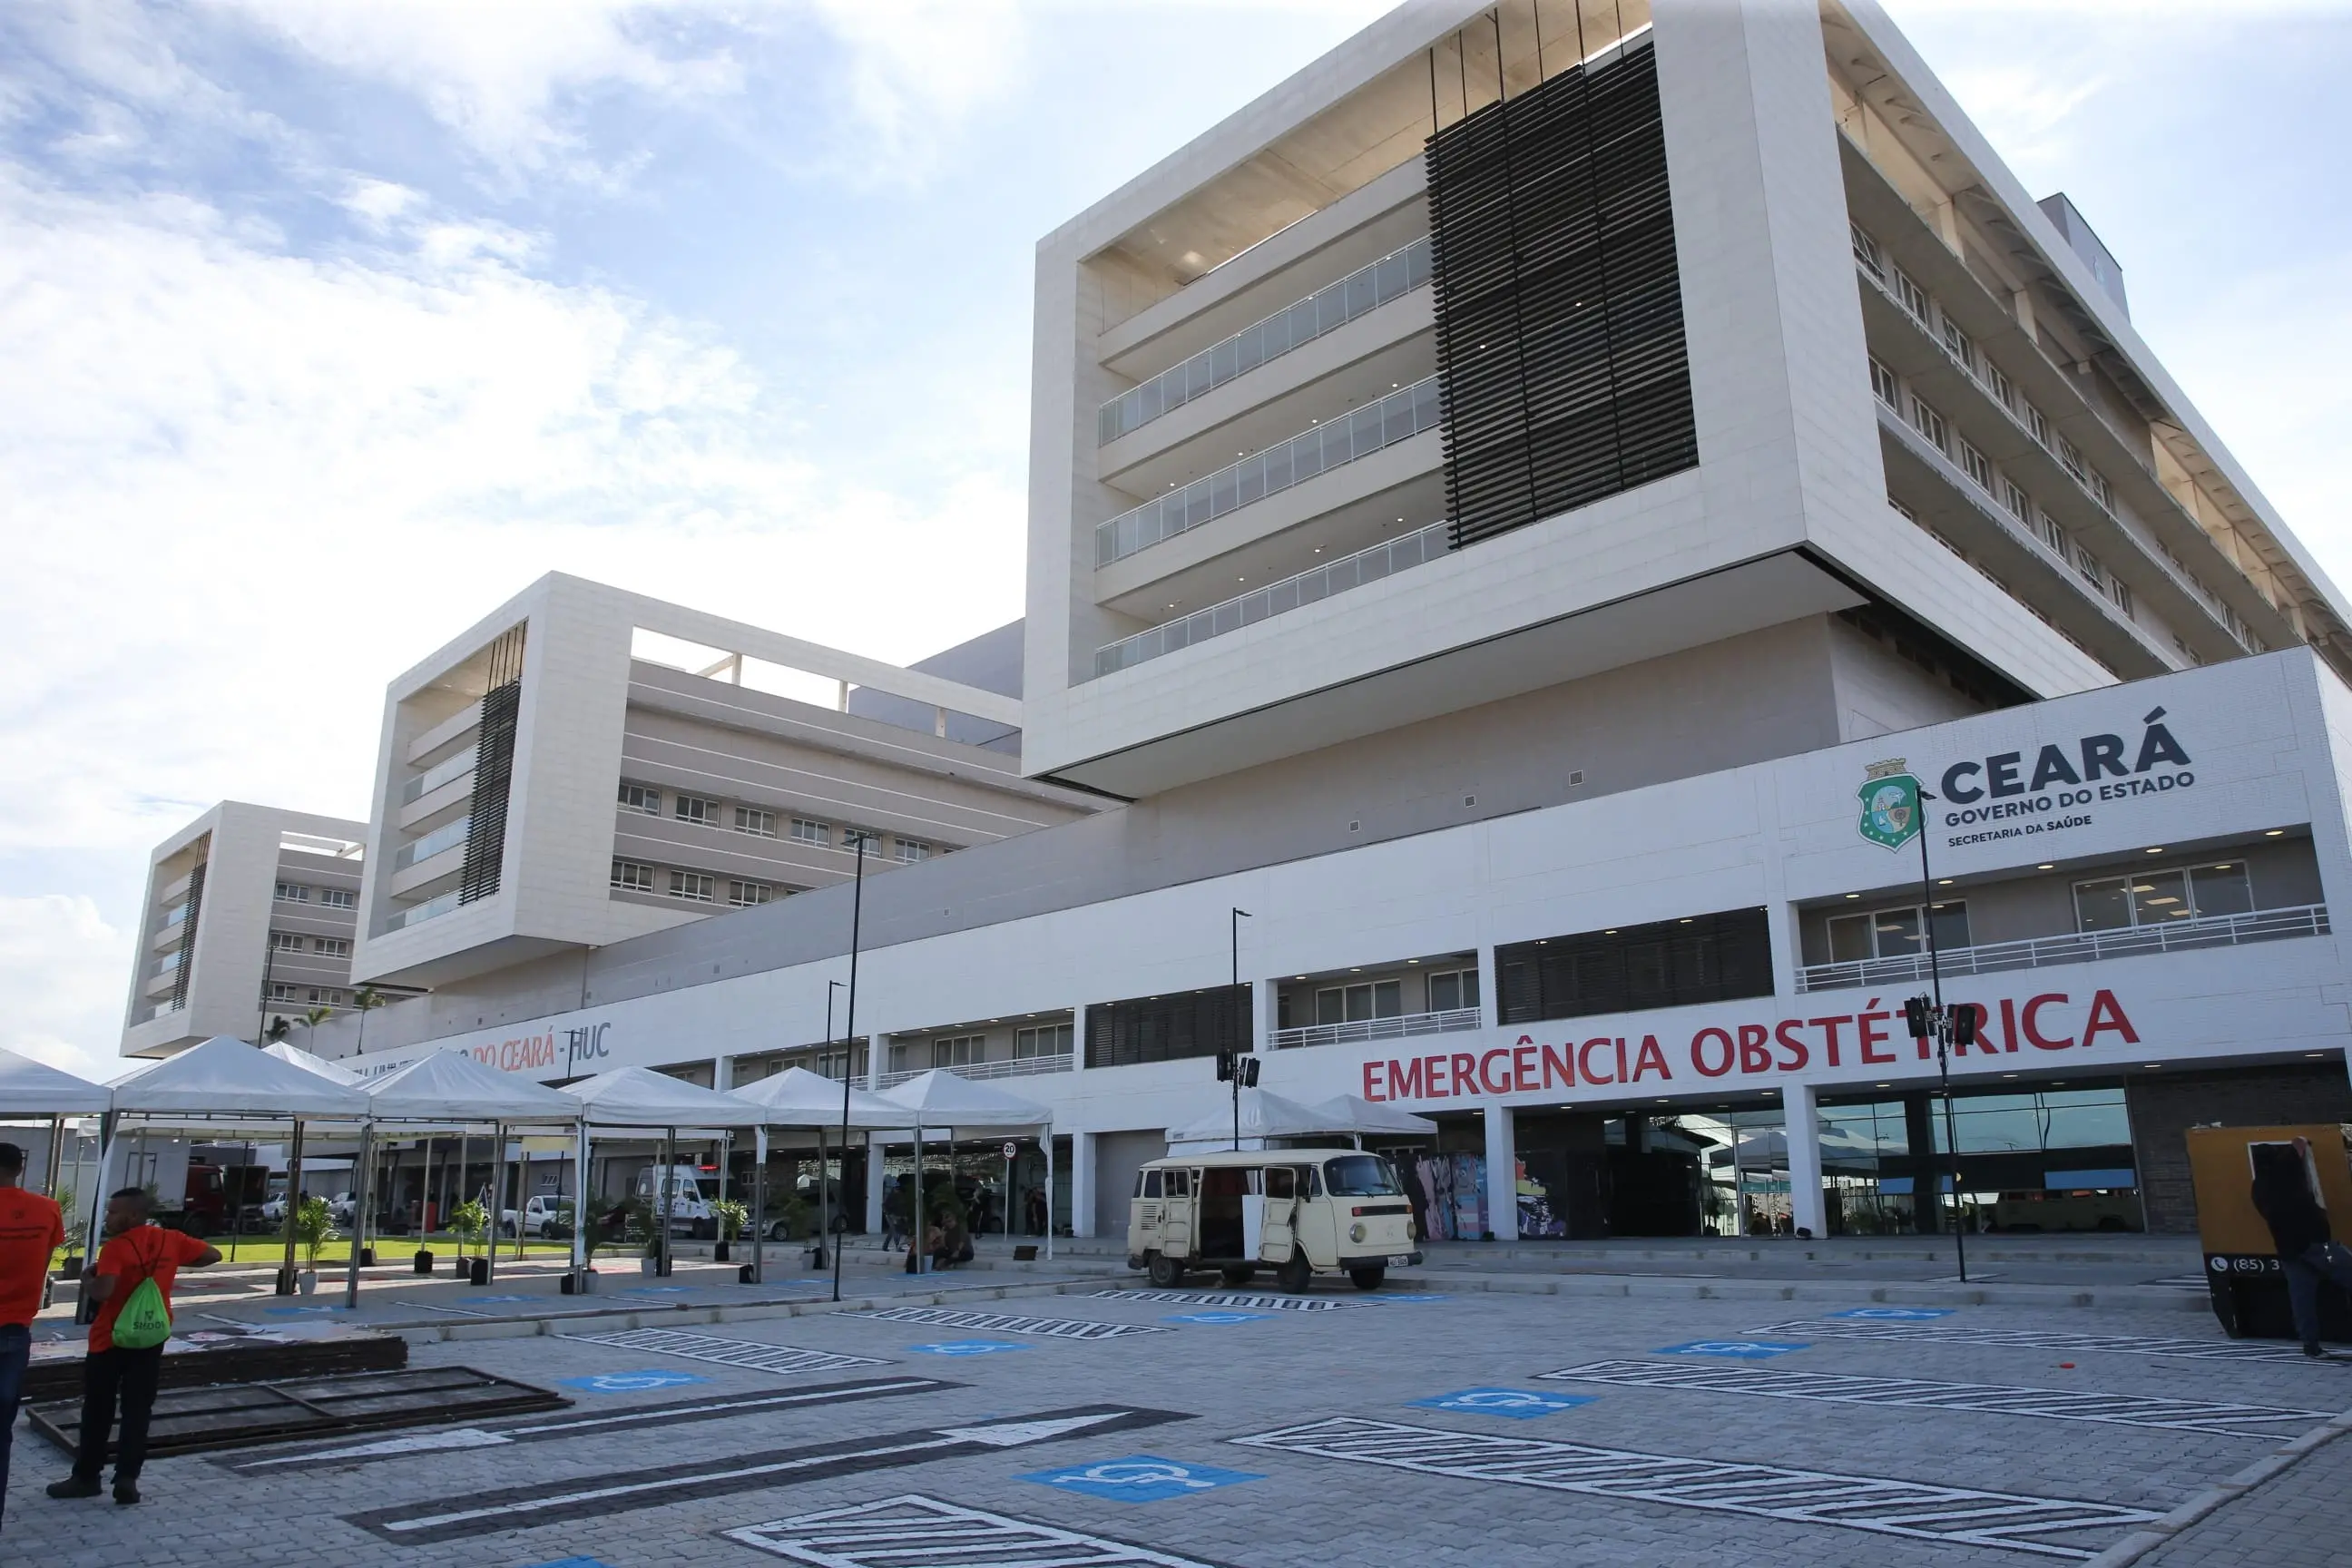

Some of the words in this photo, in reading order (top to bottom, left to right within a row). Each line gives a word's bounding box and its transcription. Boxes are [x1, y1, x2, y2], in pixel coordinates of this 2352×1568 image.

[1940, 705, 2192, 806] CEARÁ
[1944, 796, 2053, 828] GOVERNO
[2058, 789, 2092, 809] DO
[2099, 771, 2196, 802] ESTADO
[1947, 827, 2024, 848] SECRETARIA
[2025, 823, 2045, 836] DA
[2046, 814, 2092, 833] SAÚDE
[500, 1024, 555, 1072] CEARÁ
[571, 1022, 612, 1062] HUC
[1363, 1034, 1672, 1102] EMERGÊNCIA
[2233, 1259, 2265, 1272] (85)
